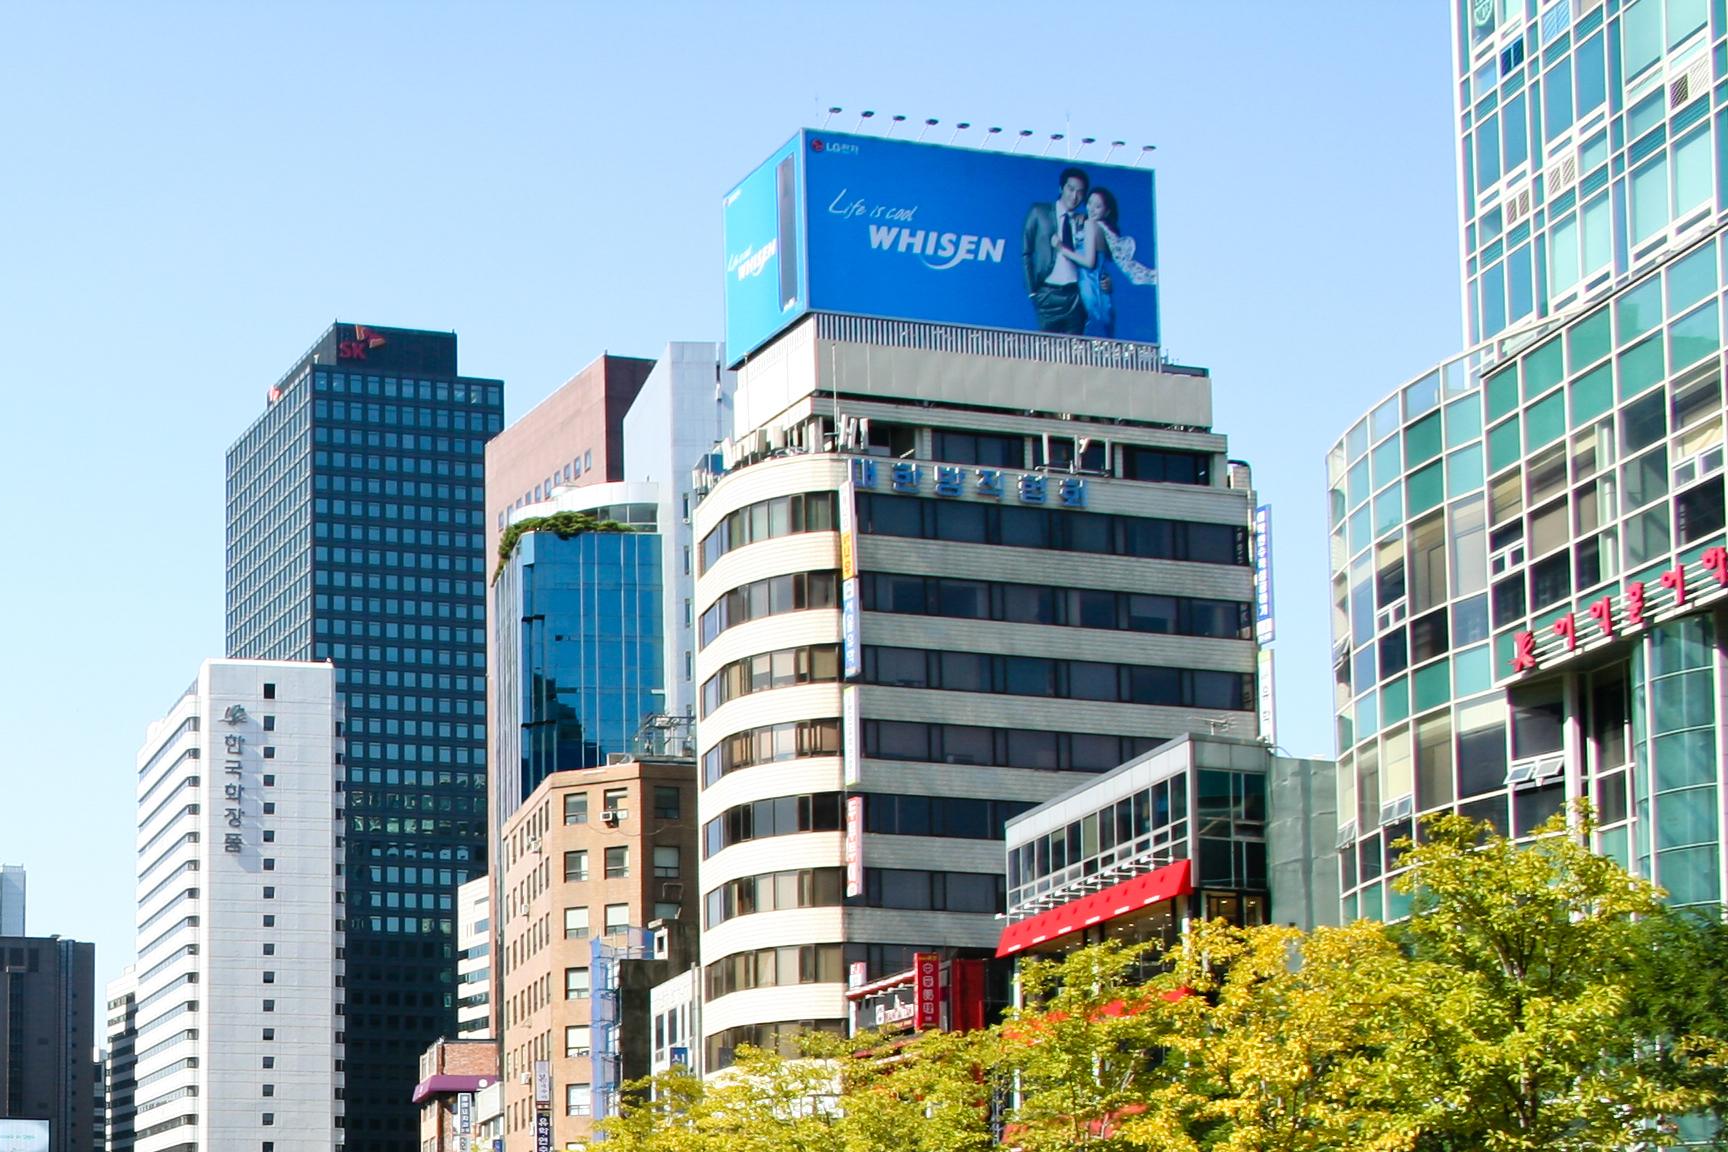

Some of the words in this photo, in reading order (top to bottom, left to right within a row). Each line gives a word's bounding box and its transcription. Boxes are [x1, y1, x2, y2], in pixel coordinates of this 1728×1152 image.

[828, 188, 867, 219] Life
[869, 204, 885, 218] is
[885, 205, 918, 222] cool
[869, 225, 1006, 269] WHISEN
[339, 340, 367, 360] SK
[848, 458, 1089, 508] 대한방직협회
[224, 734, 245, 854] 한국화장품
